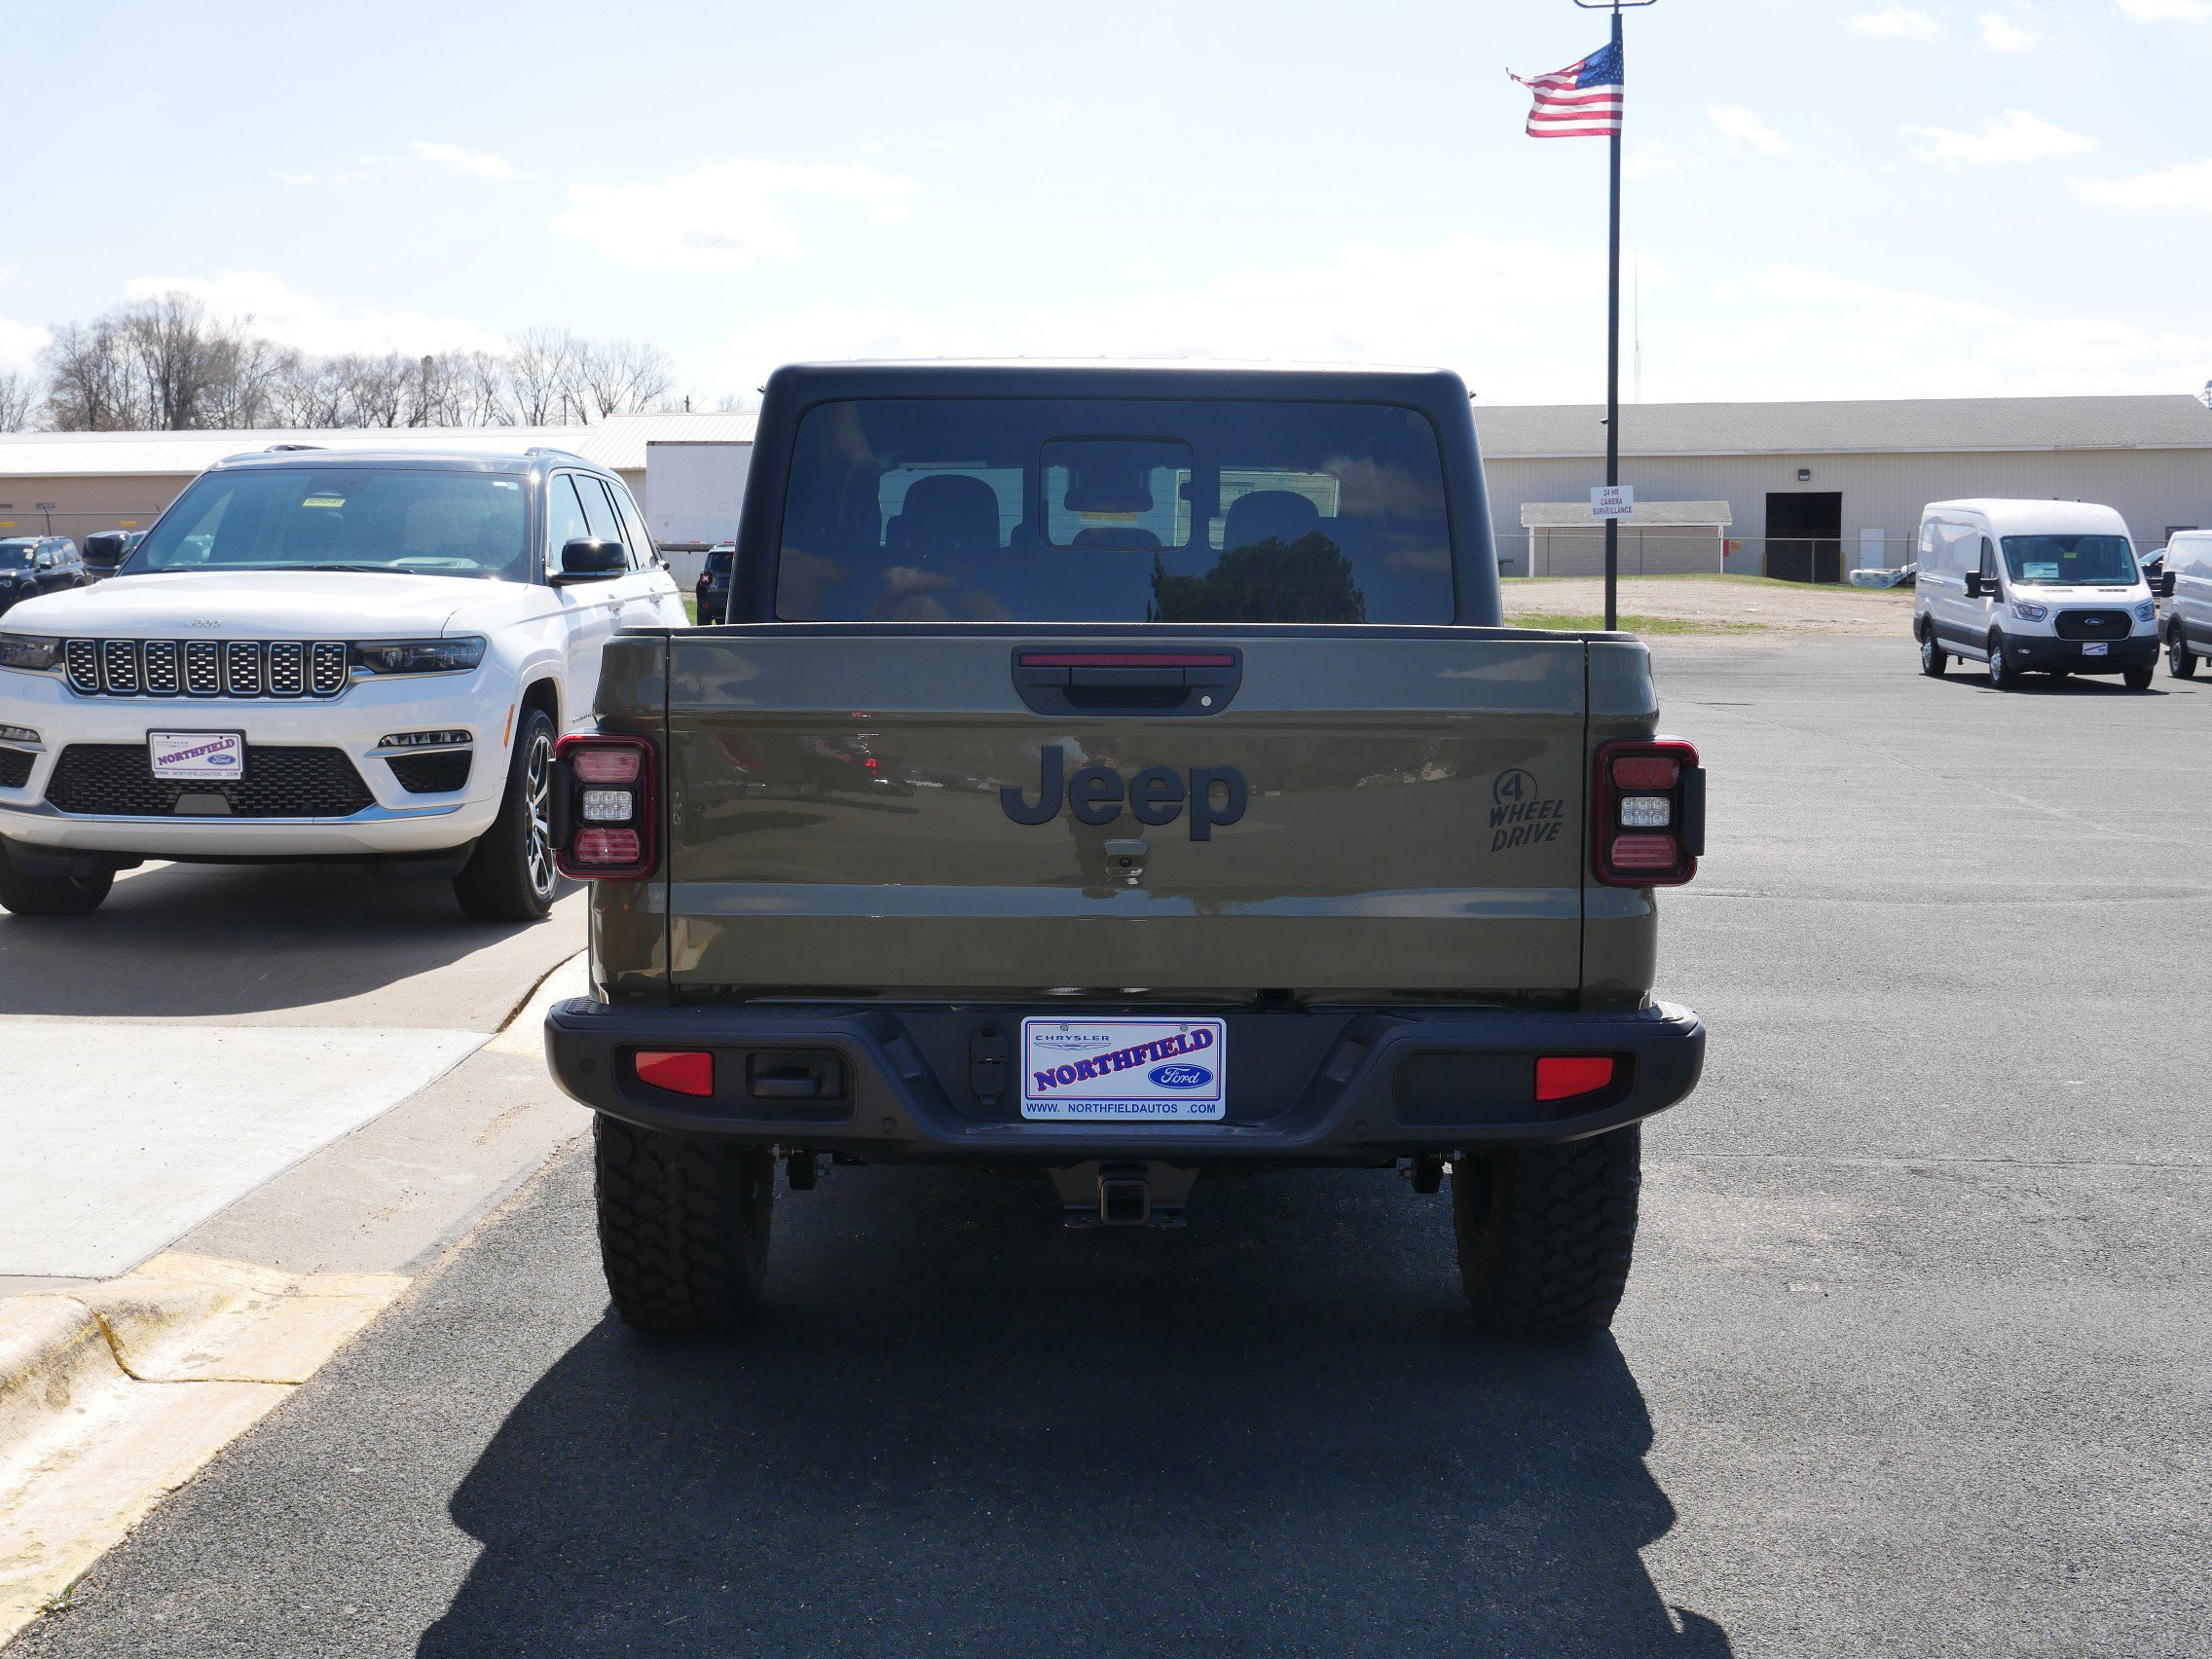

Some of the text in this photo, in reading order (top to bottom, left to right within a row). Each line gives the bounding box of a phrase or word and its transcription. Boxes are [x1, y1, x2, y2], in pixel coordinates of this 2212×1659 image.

[1611, 488, 1619, 497] HR
[1592, 505, 1633, 515] SURVEILLANCE
[157, 739, 236, 766] NORTHFIELD
[1000, 745, 1248, 842] Jeep
[1500, 773, 1524, 801] 4
[1489, 798, 1565, 830] WHEEL
[1490, 822, 1564, 854] DRIVE
[1033, 1027, 1215, 1092] NORTHFIELD
[1160, 1066, 1200, 1085] Ford
[1026, 1103, 1216, 1114] WWW. NORTHFIELDAUTOS .COM
